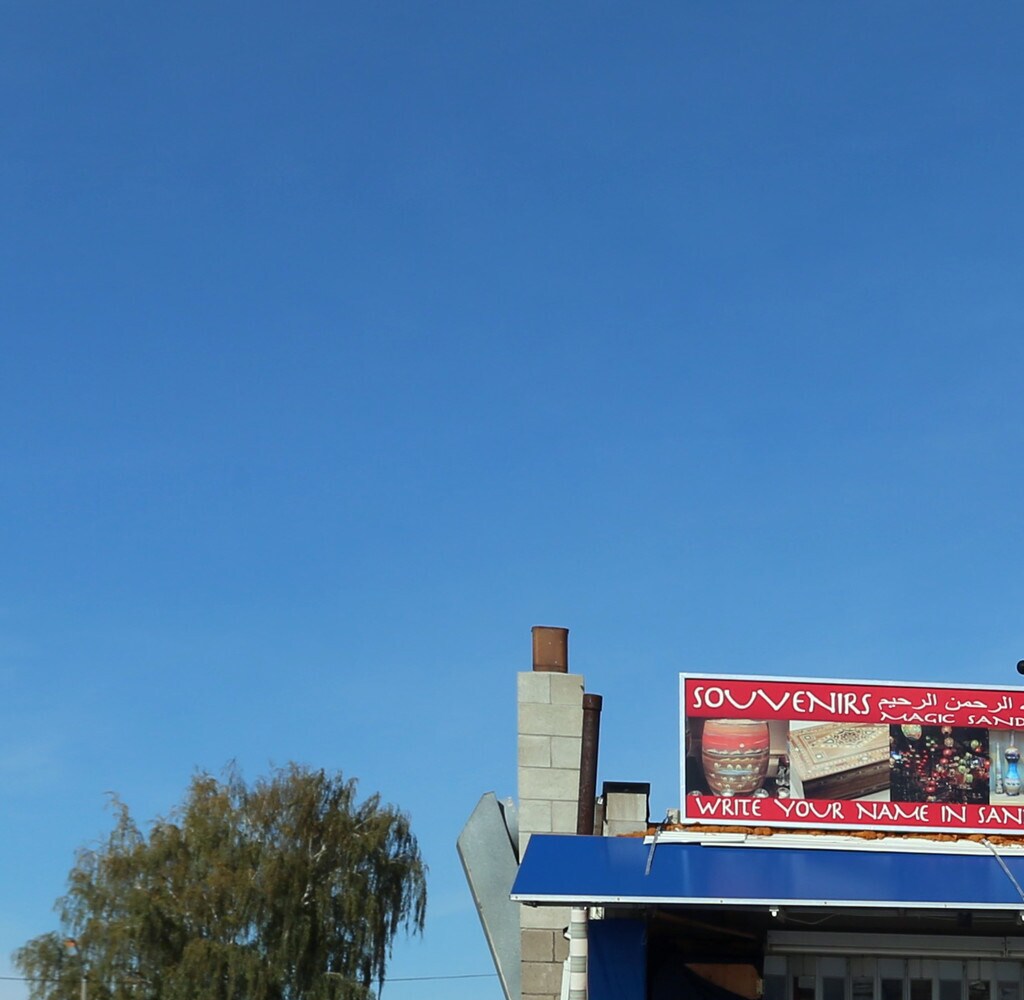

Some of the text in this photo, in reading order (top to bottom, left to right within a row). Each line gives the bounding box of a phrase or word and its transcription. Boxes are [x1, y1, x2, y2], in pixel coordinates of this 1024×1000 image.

[693, 687, 872, 714] SOUVENIRS
[878, 693, 938, 710] الرحيم
[944, 696, 1013, 713] الرحمن
[880, 712, 956, 724] MAGIC
[695, 798, 762, 816] WRITE
[774, 800, 844, 820] YOUR
[857, 802, 929, 822] NAME
[941, 804, 967, 824] IN
